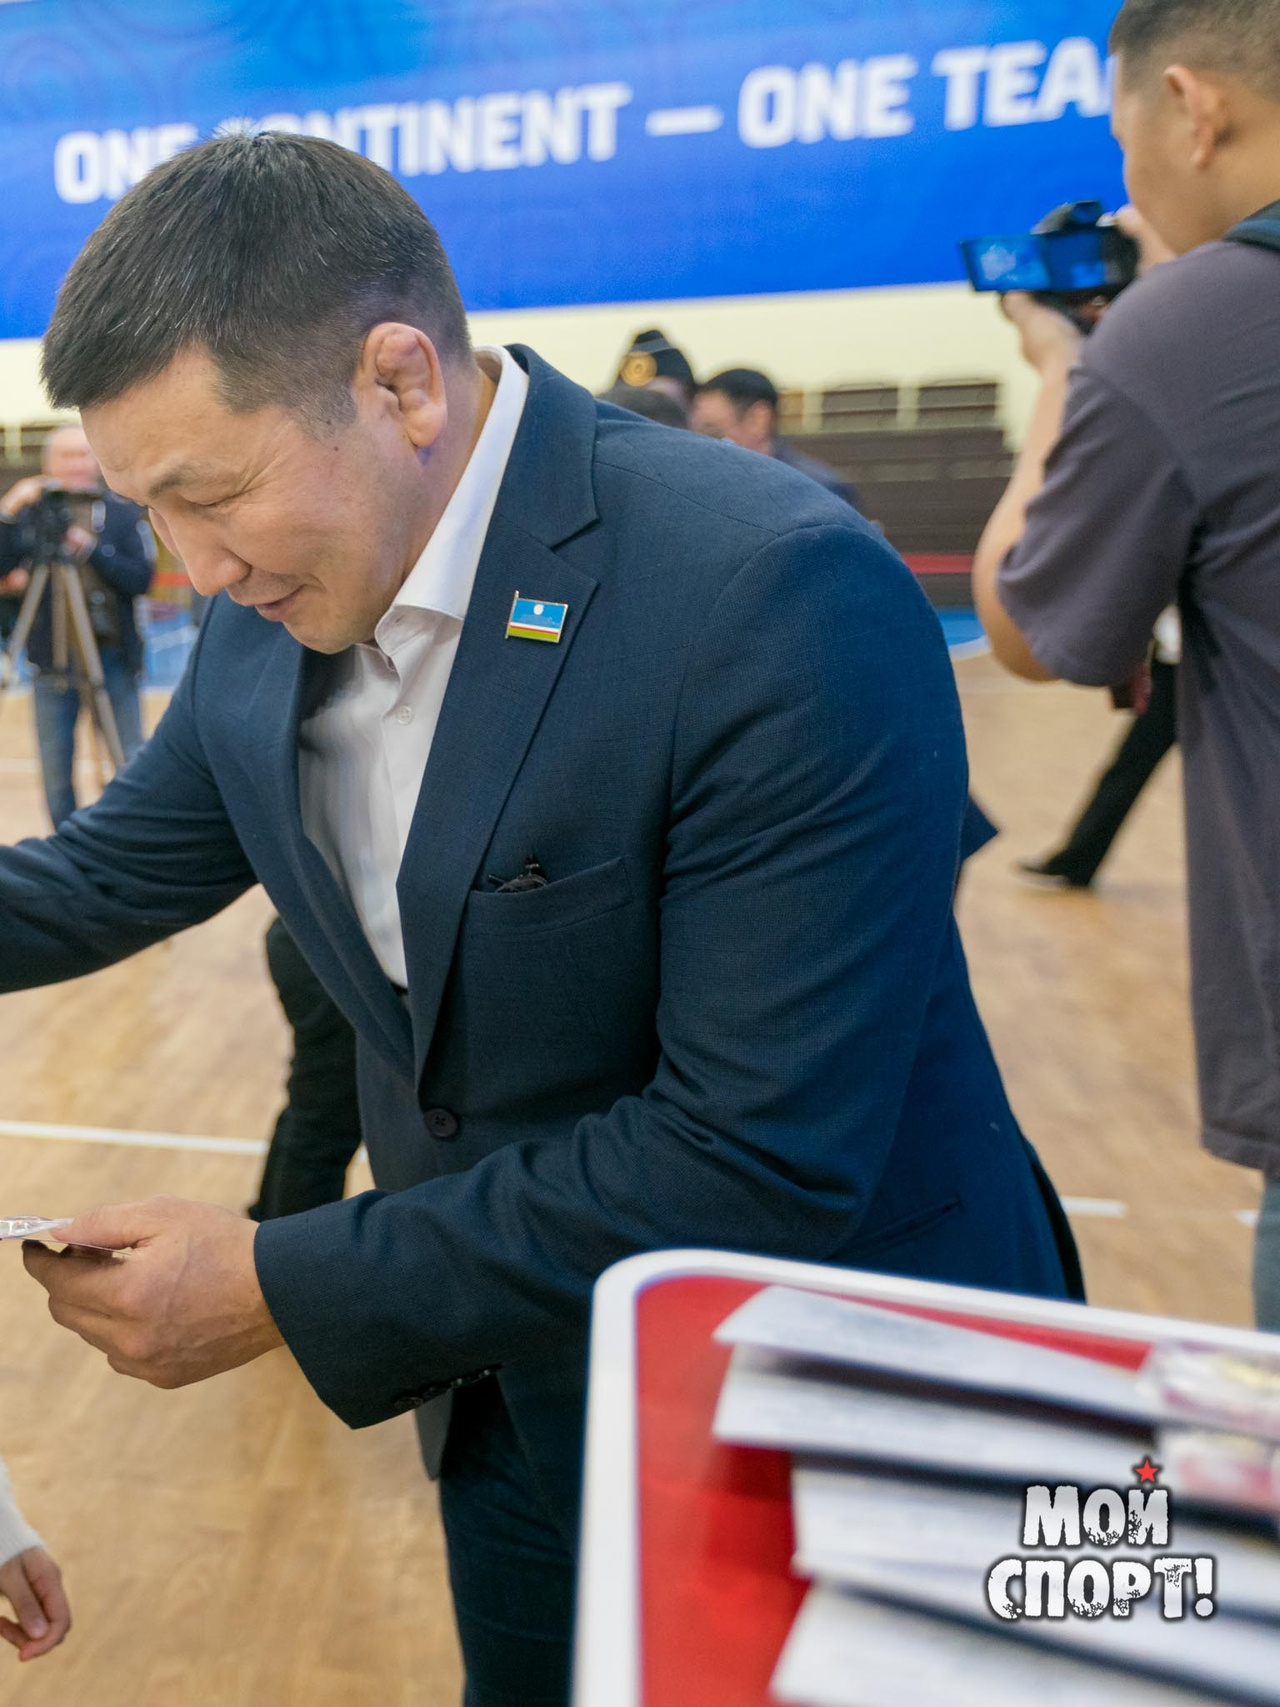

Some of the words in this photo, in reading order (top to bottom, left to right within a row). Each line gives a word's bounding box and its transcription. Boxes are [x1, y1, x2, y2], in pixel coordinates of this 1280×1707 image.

[214, 80, 633, 176] TINENT
[738, 53, 918, 149] ONE
[930, 36, 1118, 131] TEA
